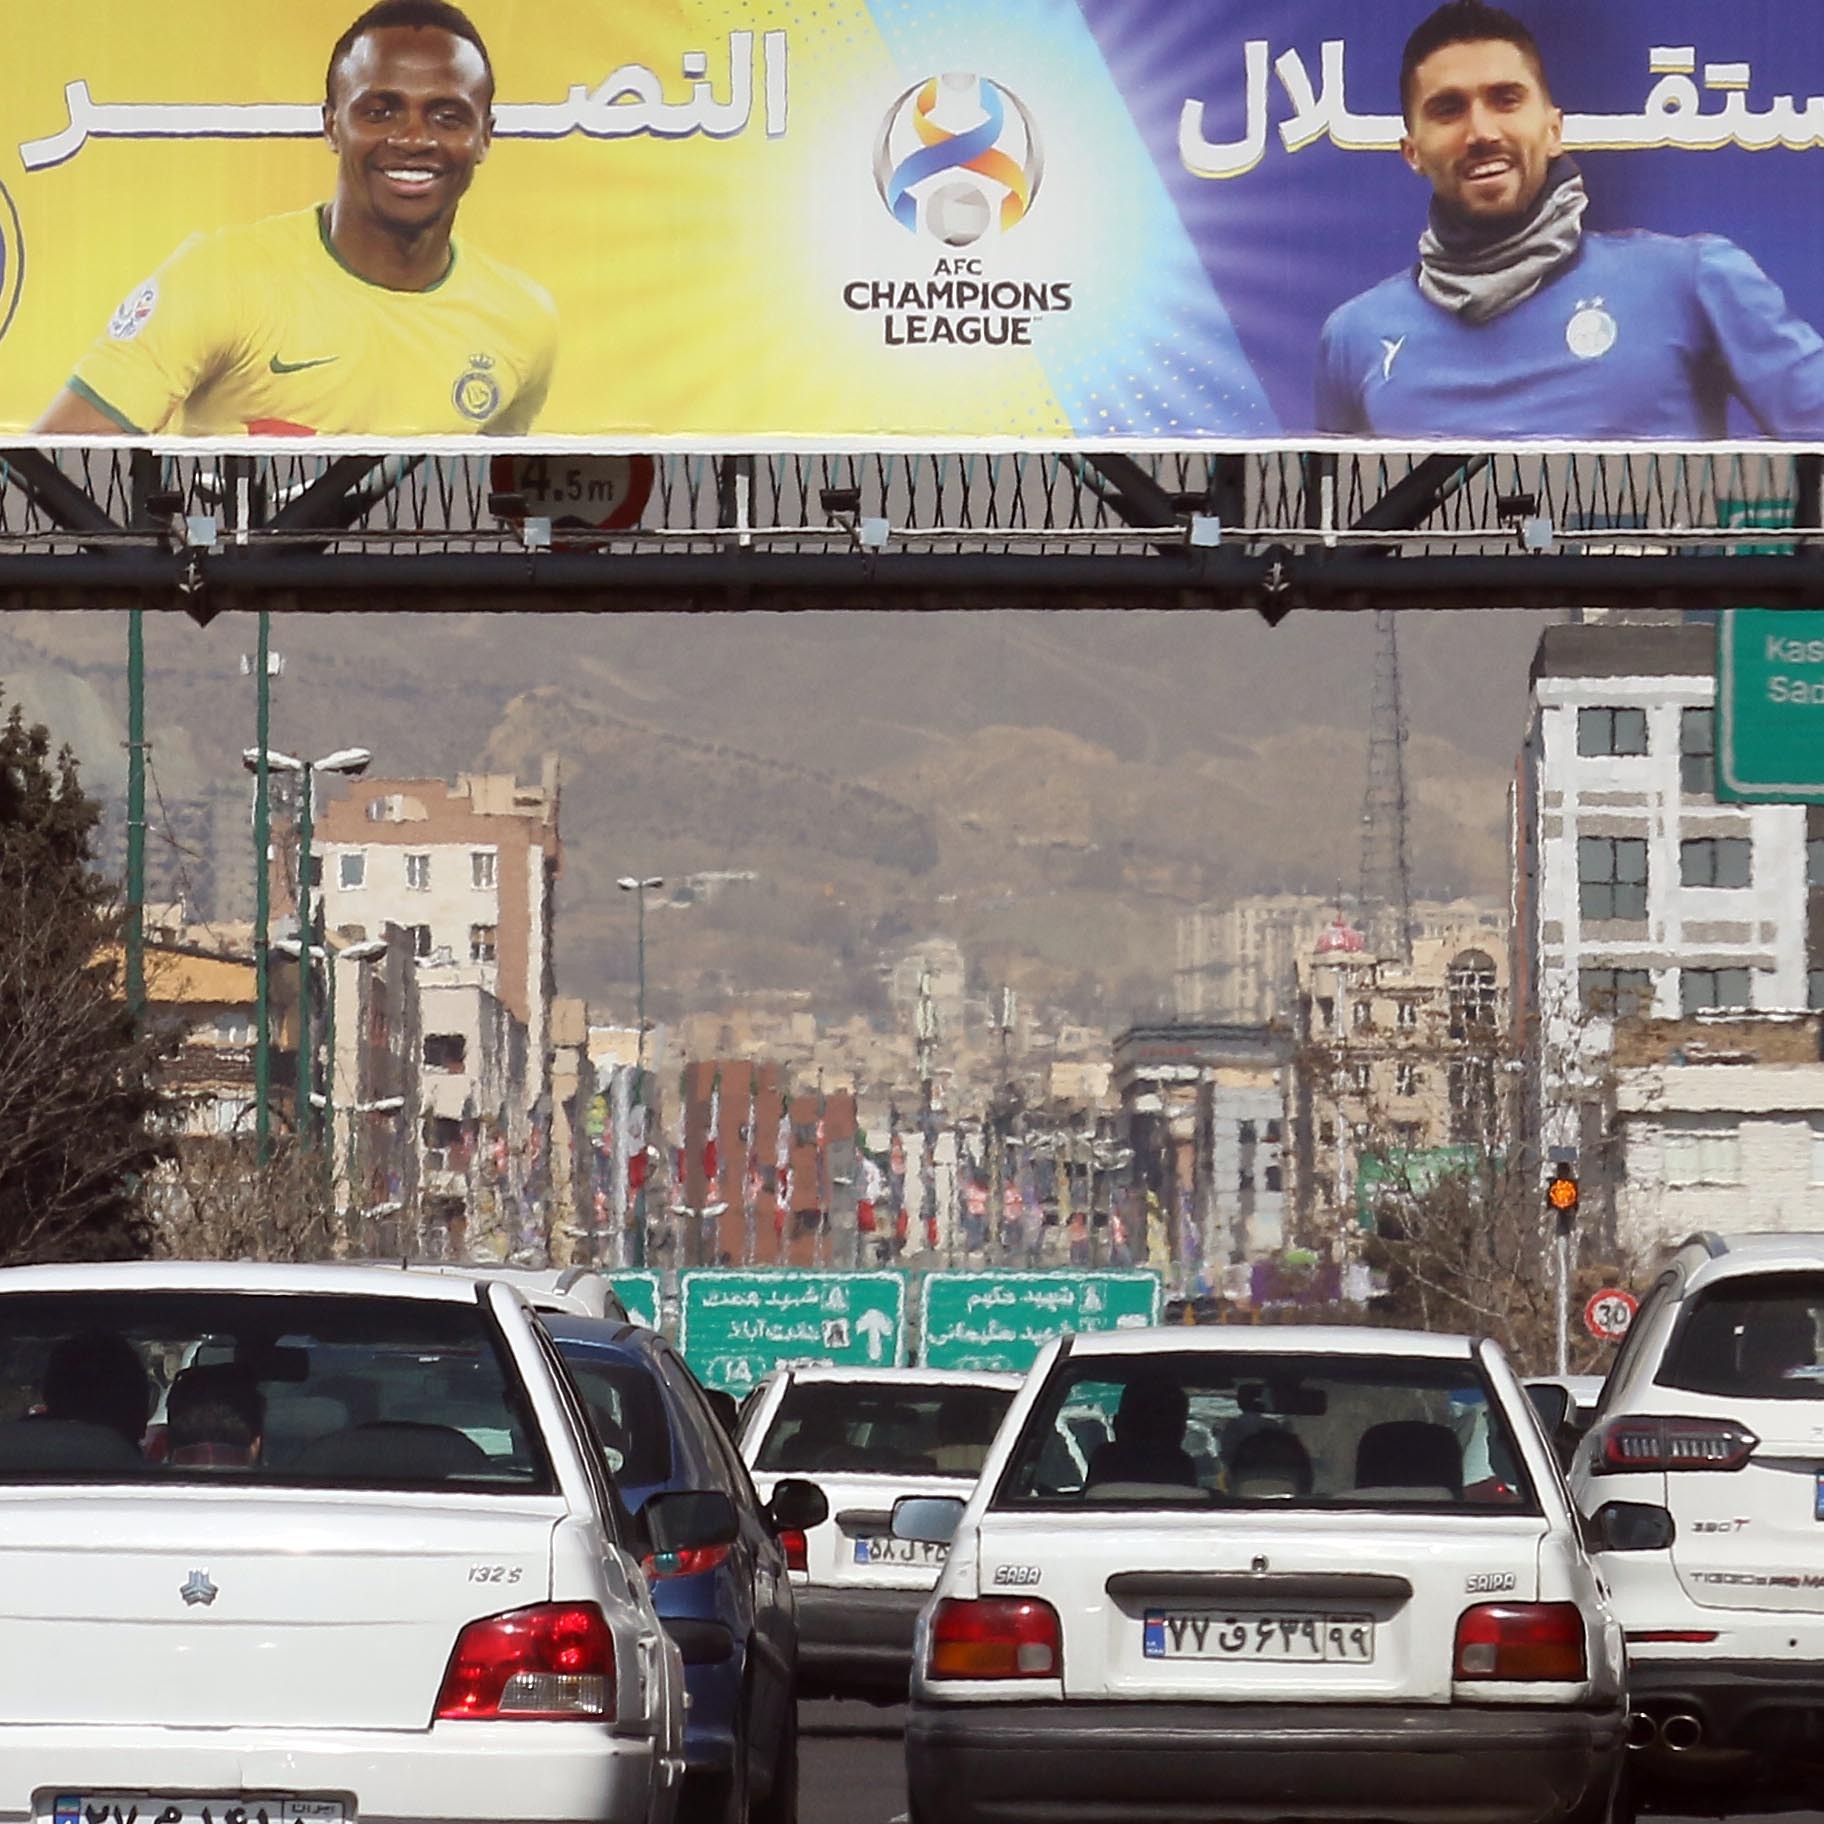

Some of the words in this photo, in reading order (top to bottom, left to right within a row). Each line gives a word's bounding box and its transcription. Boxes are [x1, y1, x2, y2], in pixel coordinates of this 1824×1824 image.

[933, 258, 983, 276] AFC
[843, 281, 1073, 310] CHAMPIONS
[885, 315, 1032, 345] LEAGUE
[1599, 1302, 1628, 1326] 30
[992, 1565, 1042, 1586] SABA
[1464, 1572, 1517, 1594] SAIPA
